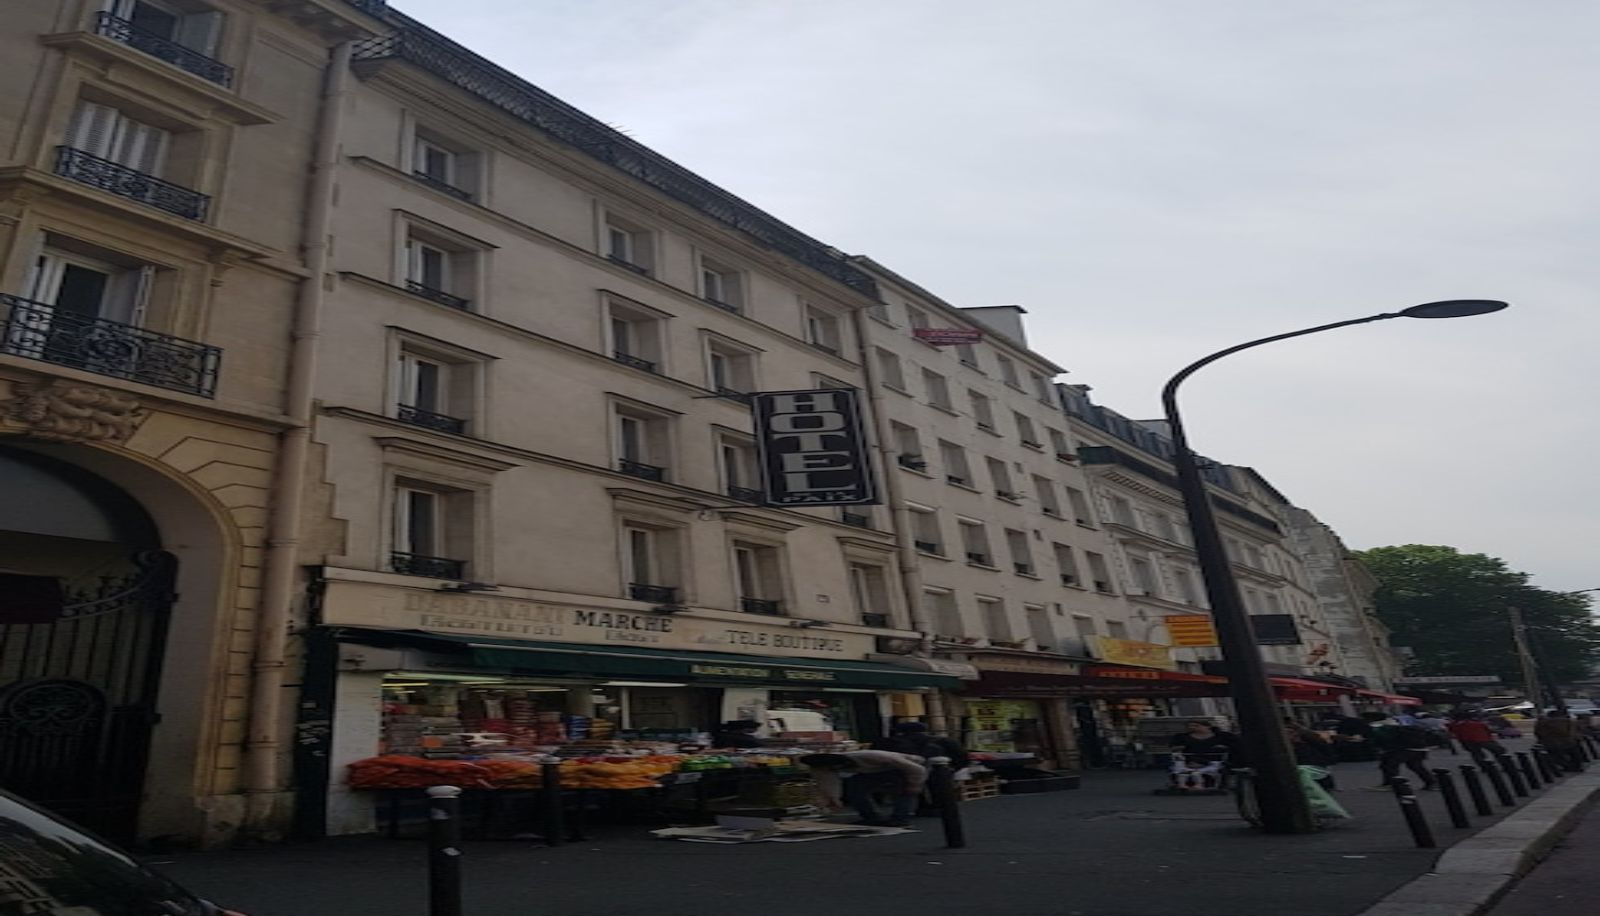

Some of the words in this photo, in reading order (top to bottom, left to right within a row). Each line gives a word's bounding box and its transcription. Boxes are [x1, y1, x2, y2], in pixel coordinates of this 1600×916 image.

[769, 393, 857, 492] HOTEL
[573, 610, 672, 632] MARCHE
[726, 629, 768, 646] TELE
